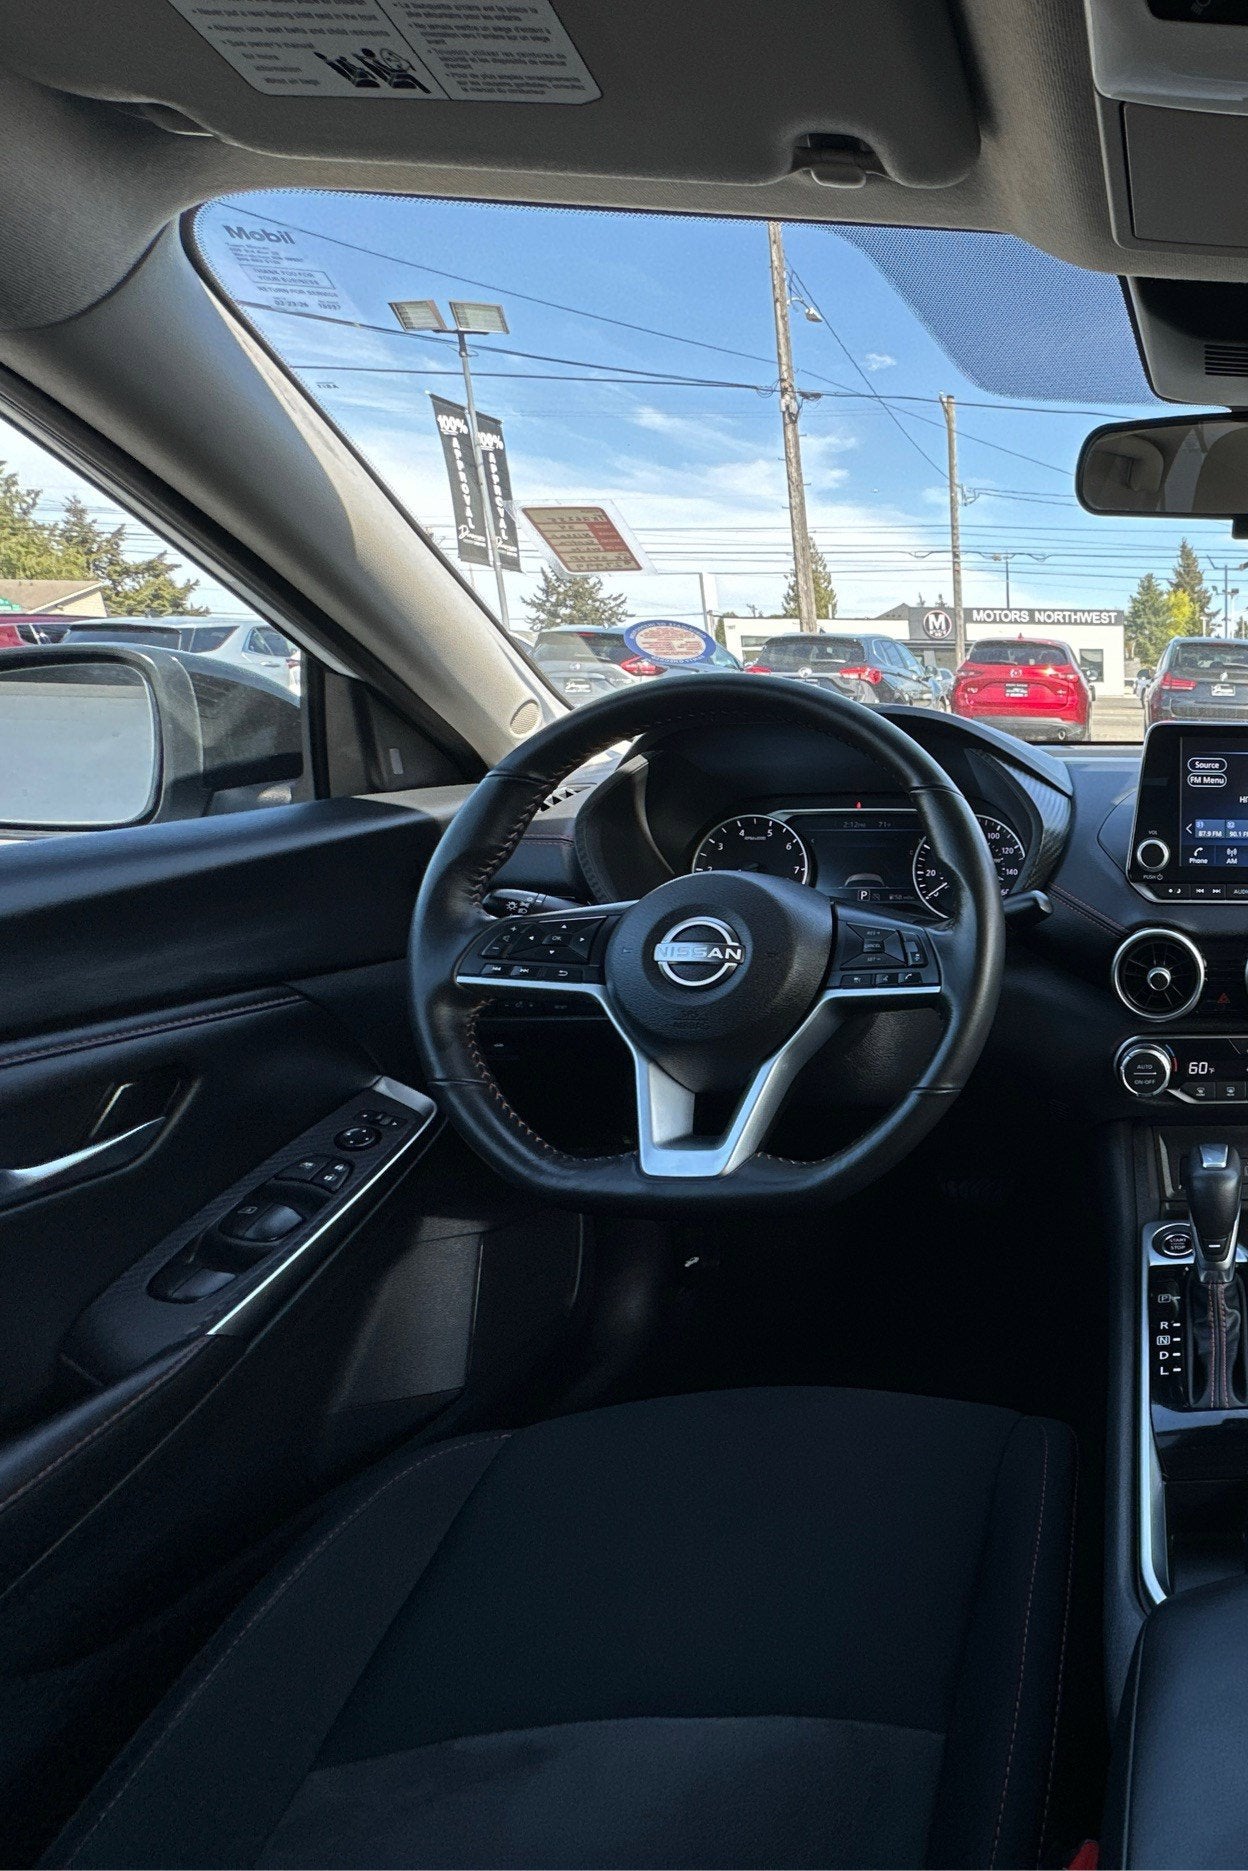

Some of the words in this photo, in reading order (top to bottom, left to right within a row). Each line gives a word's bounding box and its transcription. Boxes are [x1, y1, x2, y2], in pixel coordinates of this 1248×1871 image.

[222, 225, 296, 244] Mobil
[437, 414, 469, 435] 100%
[452, 437, 476, 530] APPROVAL
[488, 452, 509, 541] APPROVAL
[972, 610, 1030, 623] MOTORS
[1034, 611, 1118, 624] NORTHWEST
[928, 614, 946, 630] M
[1195, 761, 1220, 770] Source
[1190, 776, 1202, 784] FM
[1203, 776, 1225, 784] Menu
[987, 832, 1000, 840] 100
[1229, 830, 1243, 838] 90.1
[717, 842, 724, 850] 3
[785, 842, 792, 850] 6
[794, 866, 800, 874] 7
[925, 869, 936, 877] 20
[1006, 868, 1018, 876] 140
[859, 890, 868, 900] P
[657, 946, 742, 960] NISSAN
[1160, 1321, 1169, 1330] R
[1159, 1336, 1168, 1344] N
[1159, 1351, 1169, 1360] D
[1160, 1366, 1170, 1375] L
